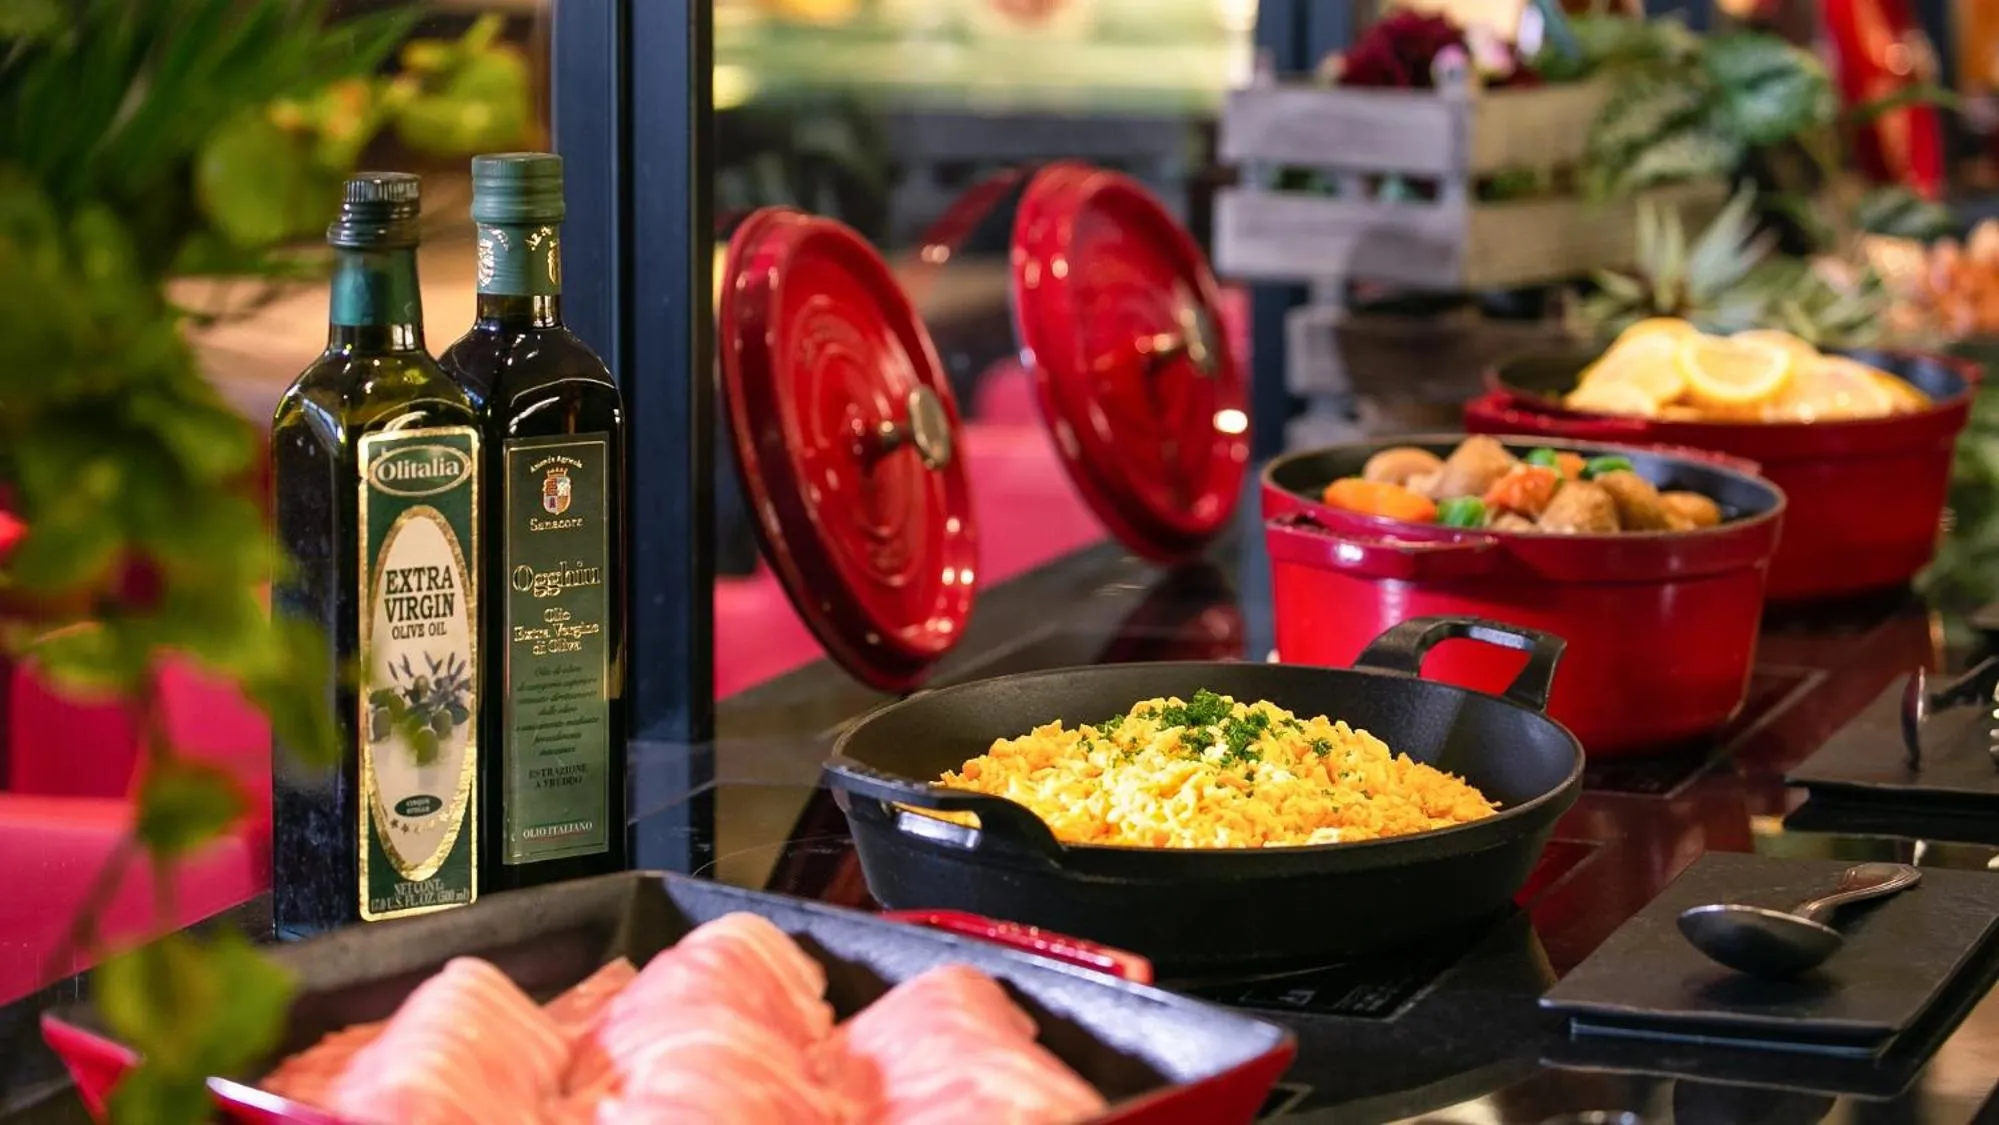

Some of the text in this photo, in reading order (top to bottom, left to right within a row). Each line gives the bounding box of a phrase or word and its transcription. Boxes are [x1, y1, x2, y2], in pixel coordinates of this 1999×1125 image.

[376, 458, 460, 482] Olitalia
[385, 565, 454, 596] EXTRA
[384, 593, 455, 623] VIRGIN
[543, 607, 572, 623] Olio
[391, 621, 448, 640] OLIVE OIL
[523, 821, 593, 839] OLIO ITALIANO
